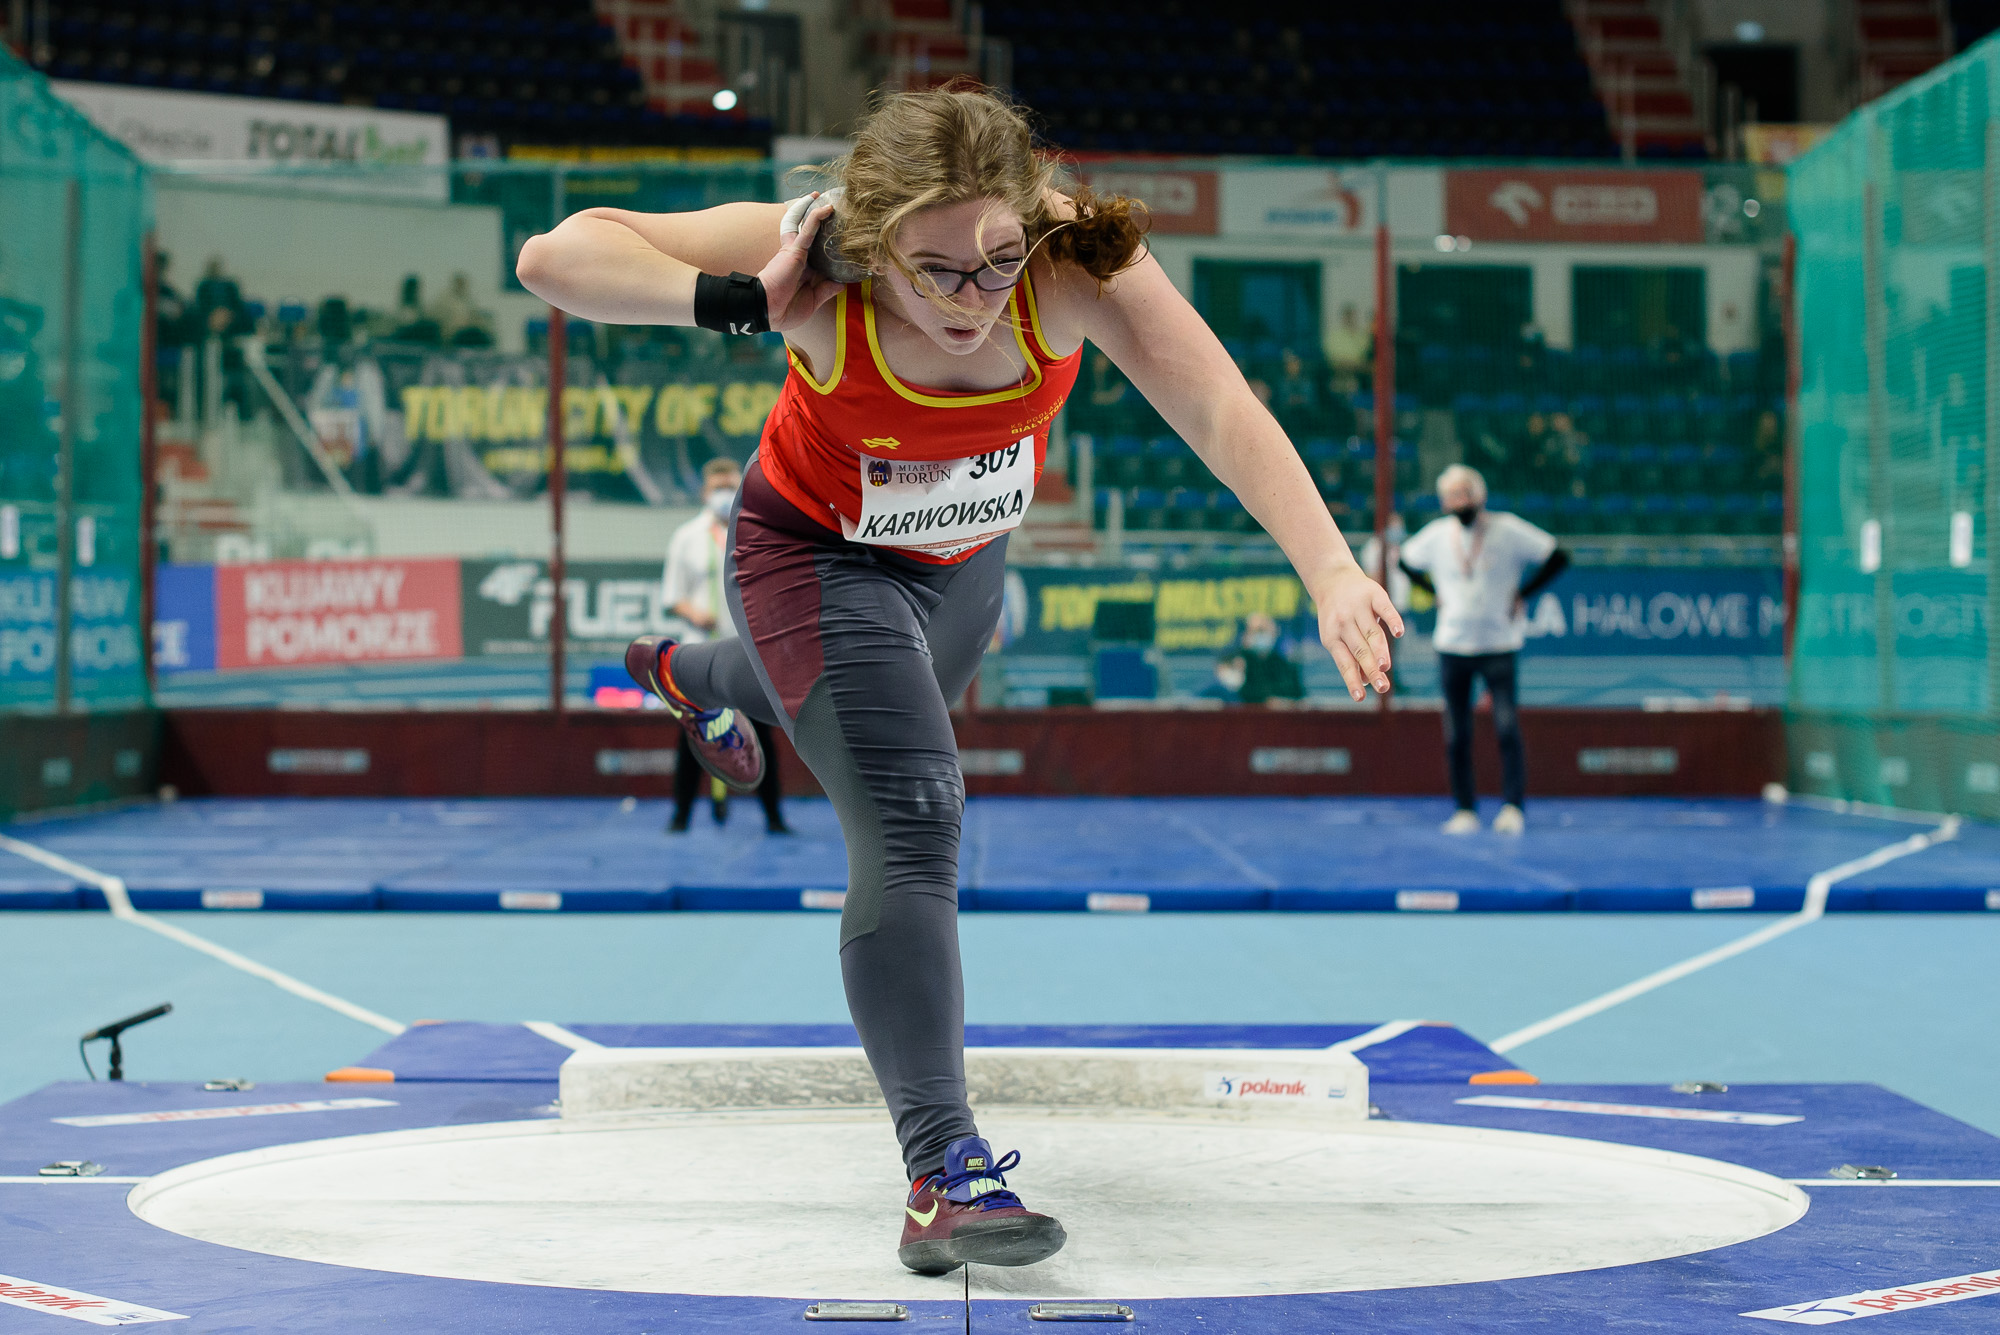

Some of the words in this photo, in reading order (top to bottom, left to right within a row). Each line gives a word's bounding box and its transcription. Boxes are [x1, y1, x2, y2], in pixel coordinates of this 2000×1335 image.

[898, 463, 940, 472] MIASTO
[969, 441, 1021, 480] 309
[896, 465, 952, 485] TORUŃ
[861, 489, 1024, 539] KARWOWSKA
[246, 611, 438, 661] POMORZE
[1239, 1078, 1307, 1097] polanik
[967, 1157, 984, 1167] NIKE
